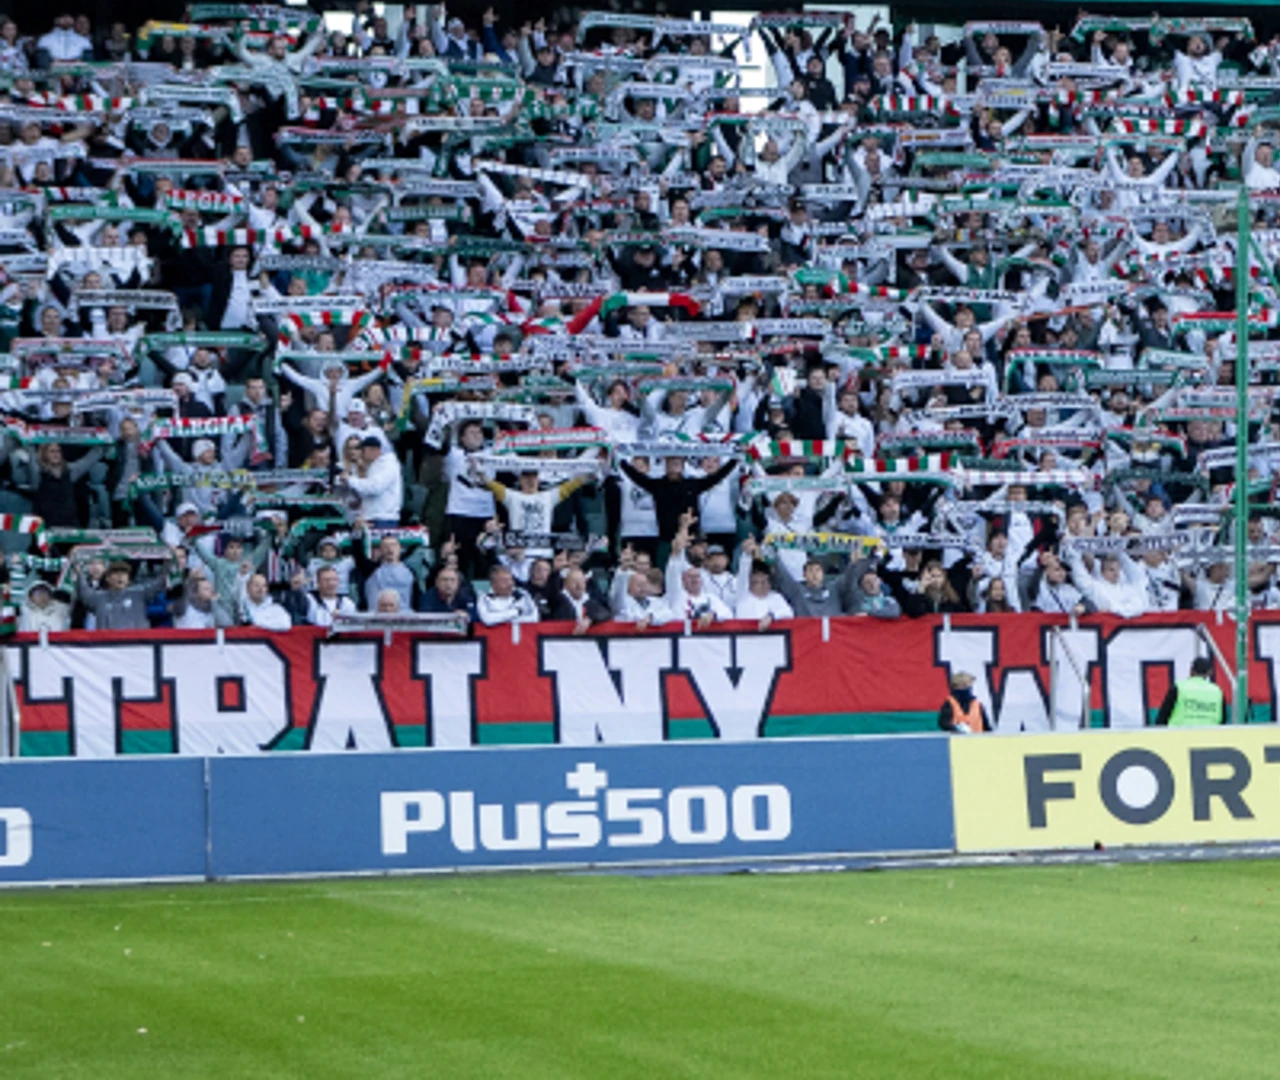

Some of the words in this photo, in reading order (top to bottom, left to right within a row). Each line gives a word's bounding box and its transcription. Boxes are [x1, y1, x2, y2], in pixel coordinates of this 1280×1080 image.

[171, 190, 240, 212] LEGIA
[179, 417, 243, 436] LEGIA
[380, 765, 793, 855] Plus500
